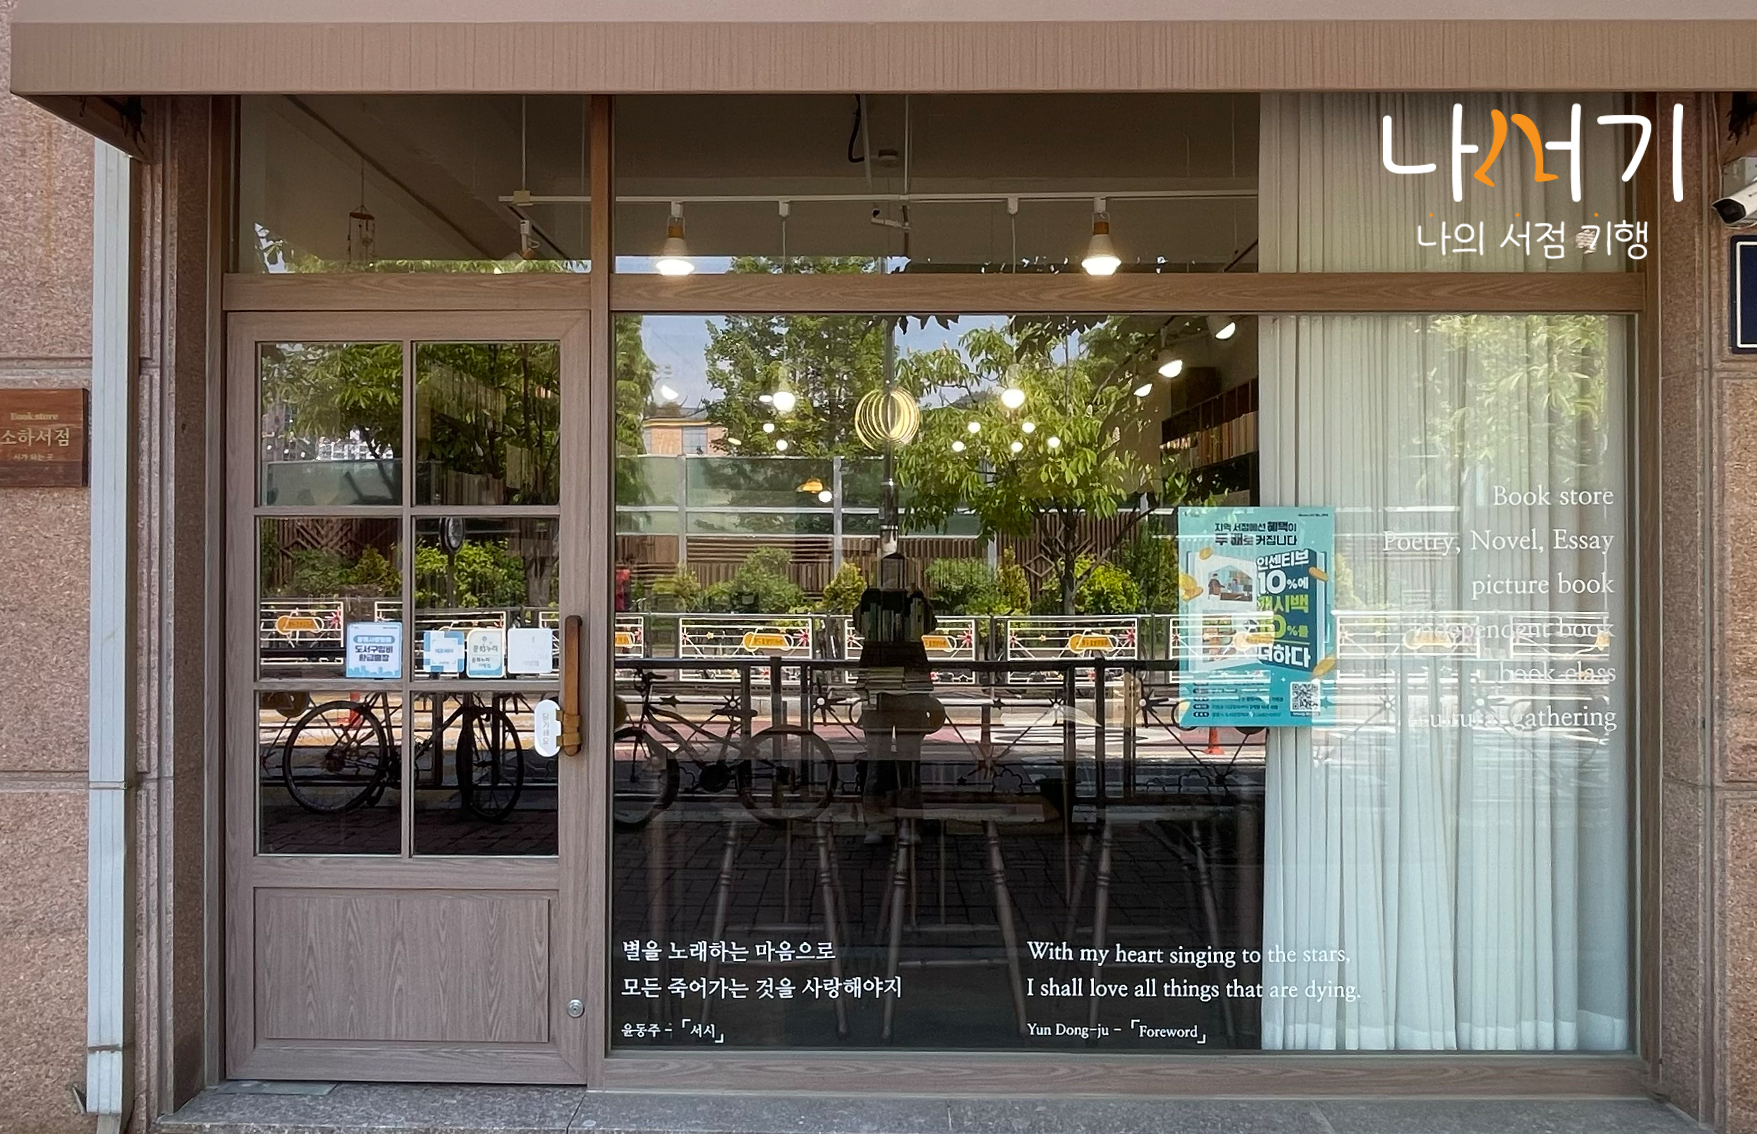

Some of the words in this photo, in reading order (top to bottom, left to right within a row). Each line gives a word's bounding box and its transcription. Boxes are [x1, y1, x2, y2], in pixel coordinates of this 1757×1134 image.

[0, 428, 70, 447] 소하서점
[1493, 485, 1552, 506] Book
[1559, 489, 1614, 506] store
[1215, 523, 1231, 532] 지역
[1256, 535, 1297, 546] 커집니다
[1383, 530, 1461, 556] Poetry,
[1470, 528, 1544, 554] Novel,
[1553, 528, 1614, 555] Essay
[1257, 549, 1309, 571] 인센티브
[1472, 574, 1549, 600] picture
[1557, 572, 1614, 594] book
[622, 940, 662, 961] 별을
[668, 940, 749, 962] 노래하는
[755, 940, 836, 962] 마음으로
[1027, 941, 1073, 960] With
[1080, 948, 1109, 967] my
[1115, 944, 1164, 963] heart
[1169, 945, 1236, 968] singing
[1242, 949, 1261, 963] to
[1268, 945, 1296, 963] the
[1303, 949, 1350, 963] stars,
[621, 977, 662, 998] 모든
[667, 977, 749, 999] 죽어가는
[755, 977, 796, 999] 것을
[802, 976, 902, 999] 사랑해야지
[1027, 978, 1034, 996] I
[1040, 978, 1083, 997] shall
[1090, 978, 1128, 997] love
[1134, 978, 1156, 997] all
[1163, 978, 1219, 1002] things
[1226, 979, 1263, 997] that
[1269, 984, 1298, 998] are
[1304, 980, 1361, 1002] dying.
[621, 1023, 661, 1038] 윤동주
[1027, 1023, 1051, 1035] Yun
[1055, 1023, 1109, 1039] Dong-ju
